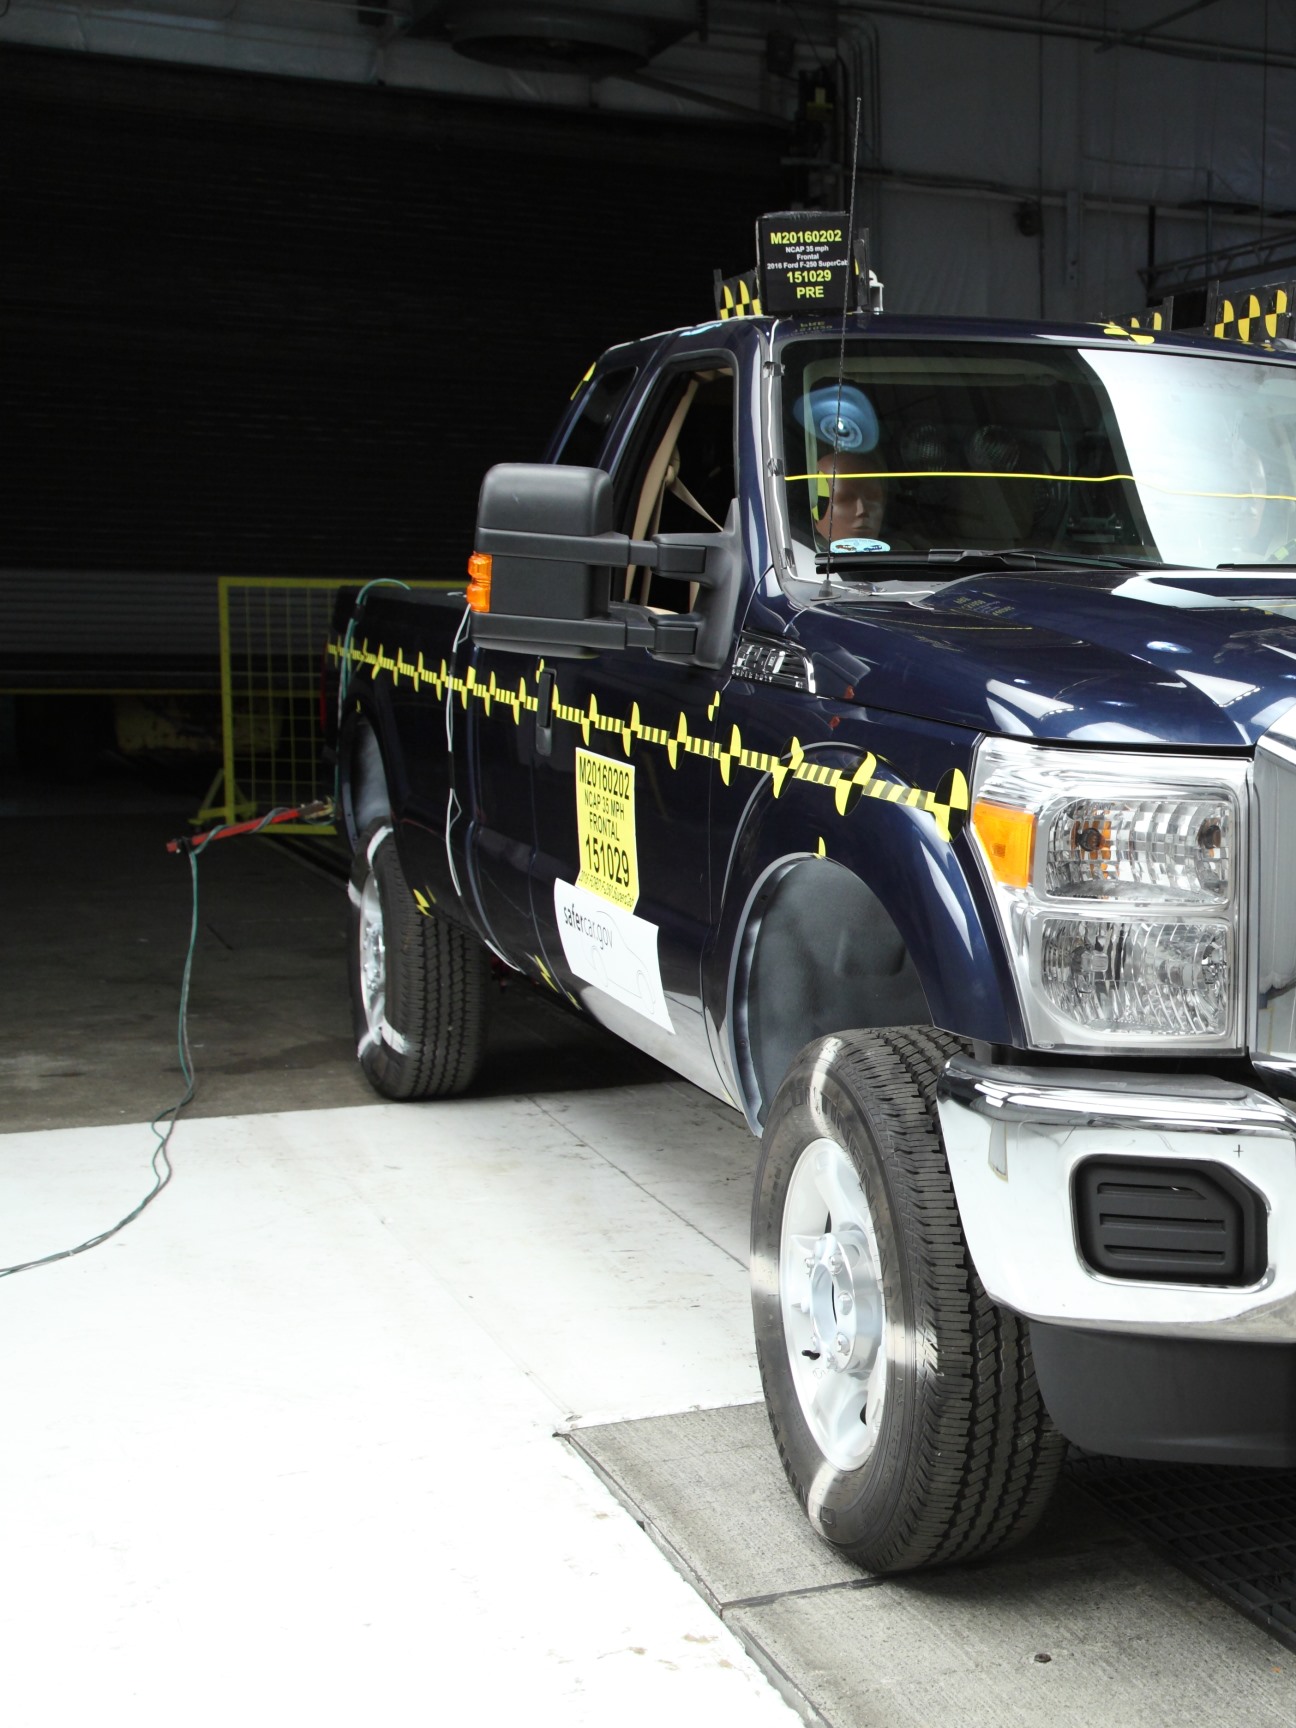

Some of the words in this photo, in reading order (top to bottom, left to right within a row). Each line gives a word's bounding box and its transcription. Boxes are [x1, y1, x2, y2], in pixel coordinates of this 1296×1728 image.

[770, 230, 842, 244] M20160202
[814, 245, 829, 254] mph
[787, 270, 832, 283] 151029
[796, 286, 824, 299] PRE
[579, 755, 630, 800] M20160202
[584, 789, 601, 811] NCAP
[602, 796, 609, 814] 35
[610, 799, 625, 821] MPH
[589, 811, 620, 841] FRONTAL
[586, 834, 630, 888] 151029
[563, 903, 613, 950] safercar.gov
